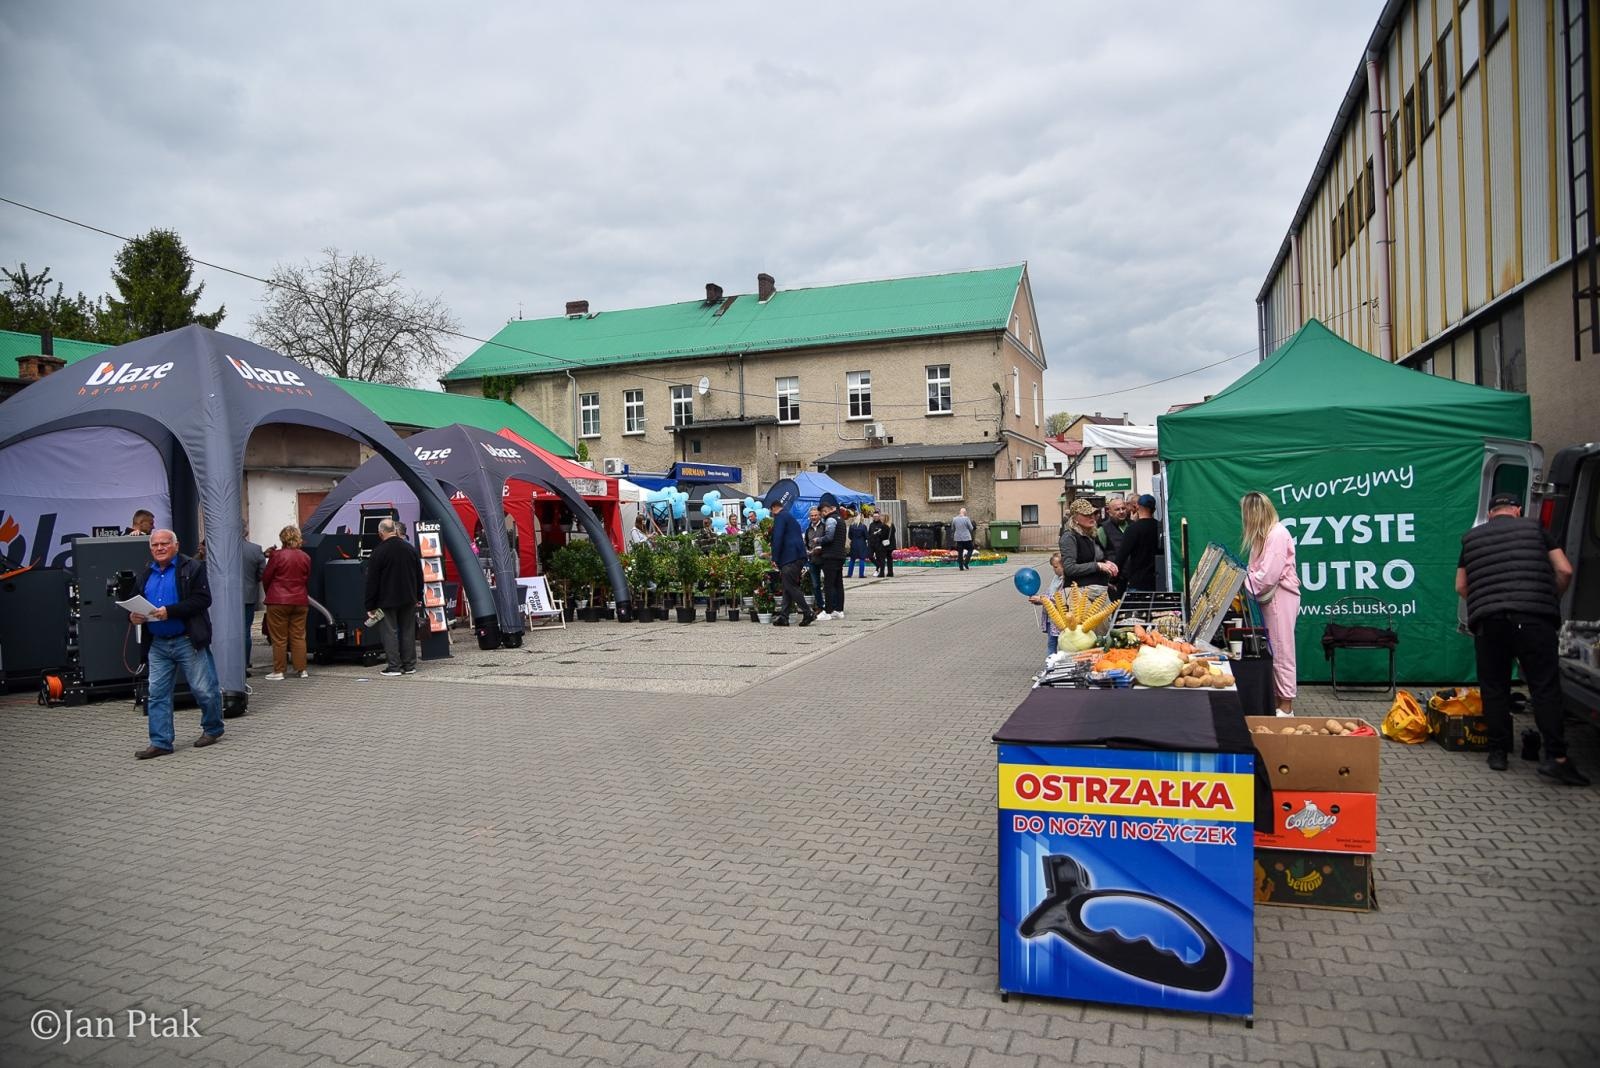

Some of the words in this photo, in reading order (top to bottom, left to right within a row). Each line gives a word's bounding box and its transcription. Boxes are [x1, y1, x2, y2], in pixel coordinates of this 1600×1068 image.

[86, 361, 174, 386] blaze
[225, 354, 306, 387] blaze
[78, 381, 160, 396] harmony
[414, 446, 452, 461] laze
[480, 442, 522, 459] blaze
[1273, 465, 1414, 505] Tworzymy
[416, 522, 441, 532] blaze
[1301, 559, 1415, 591] UTRO
[1297, 600, 1416, 616] ww.sas.busko.pl
[1015, 773, 1234, 810] OSTRZAŁKA
[1014, 816, 1044, 833] DO
[1049, 815, 1105, 837] NOŻY
[1109, 820, 1117, 838] I
[1122, 819, 1237, 845] NOŻYCZEK
[1285, 812, 1337, 830] Cordero
